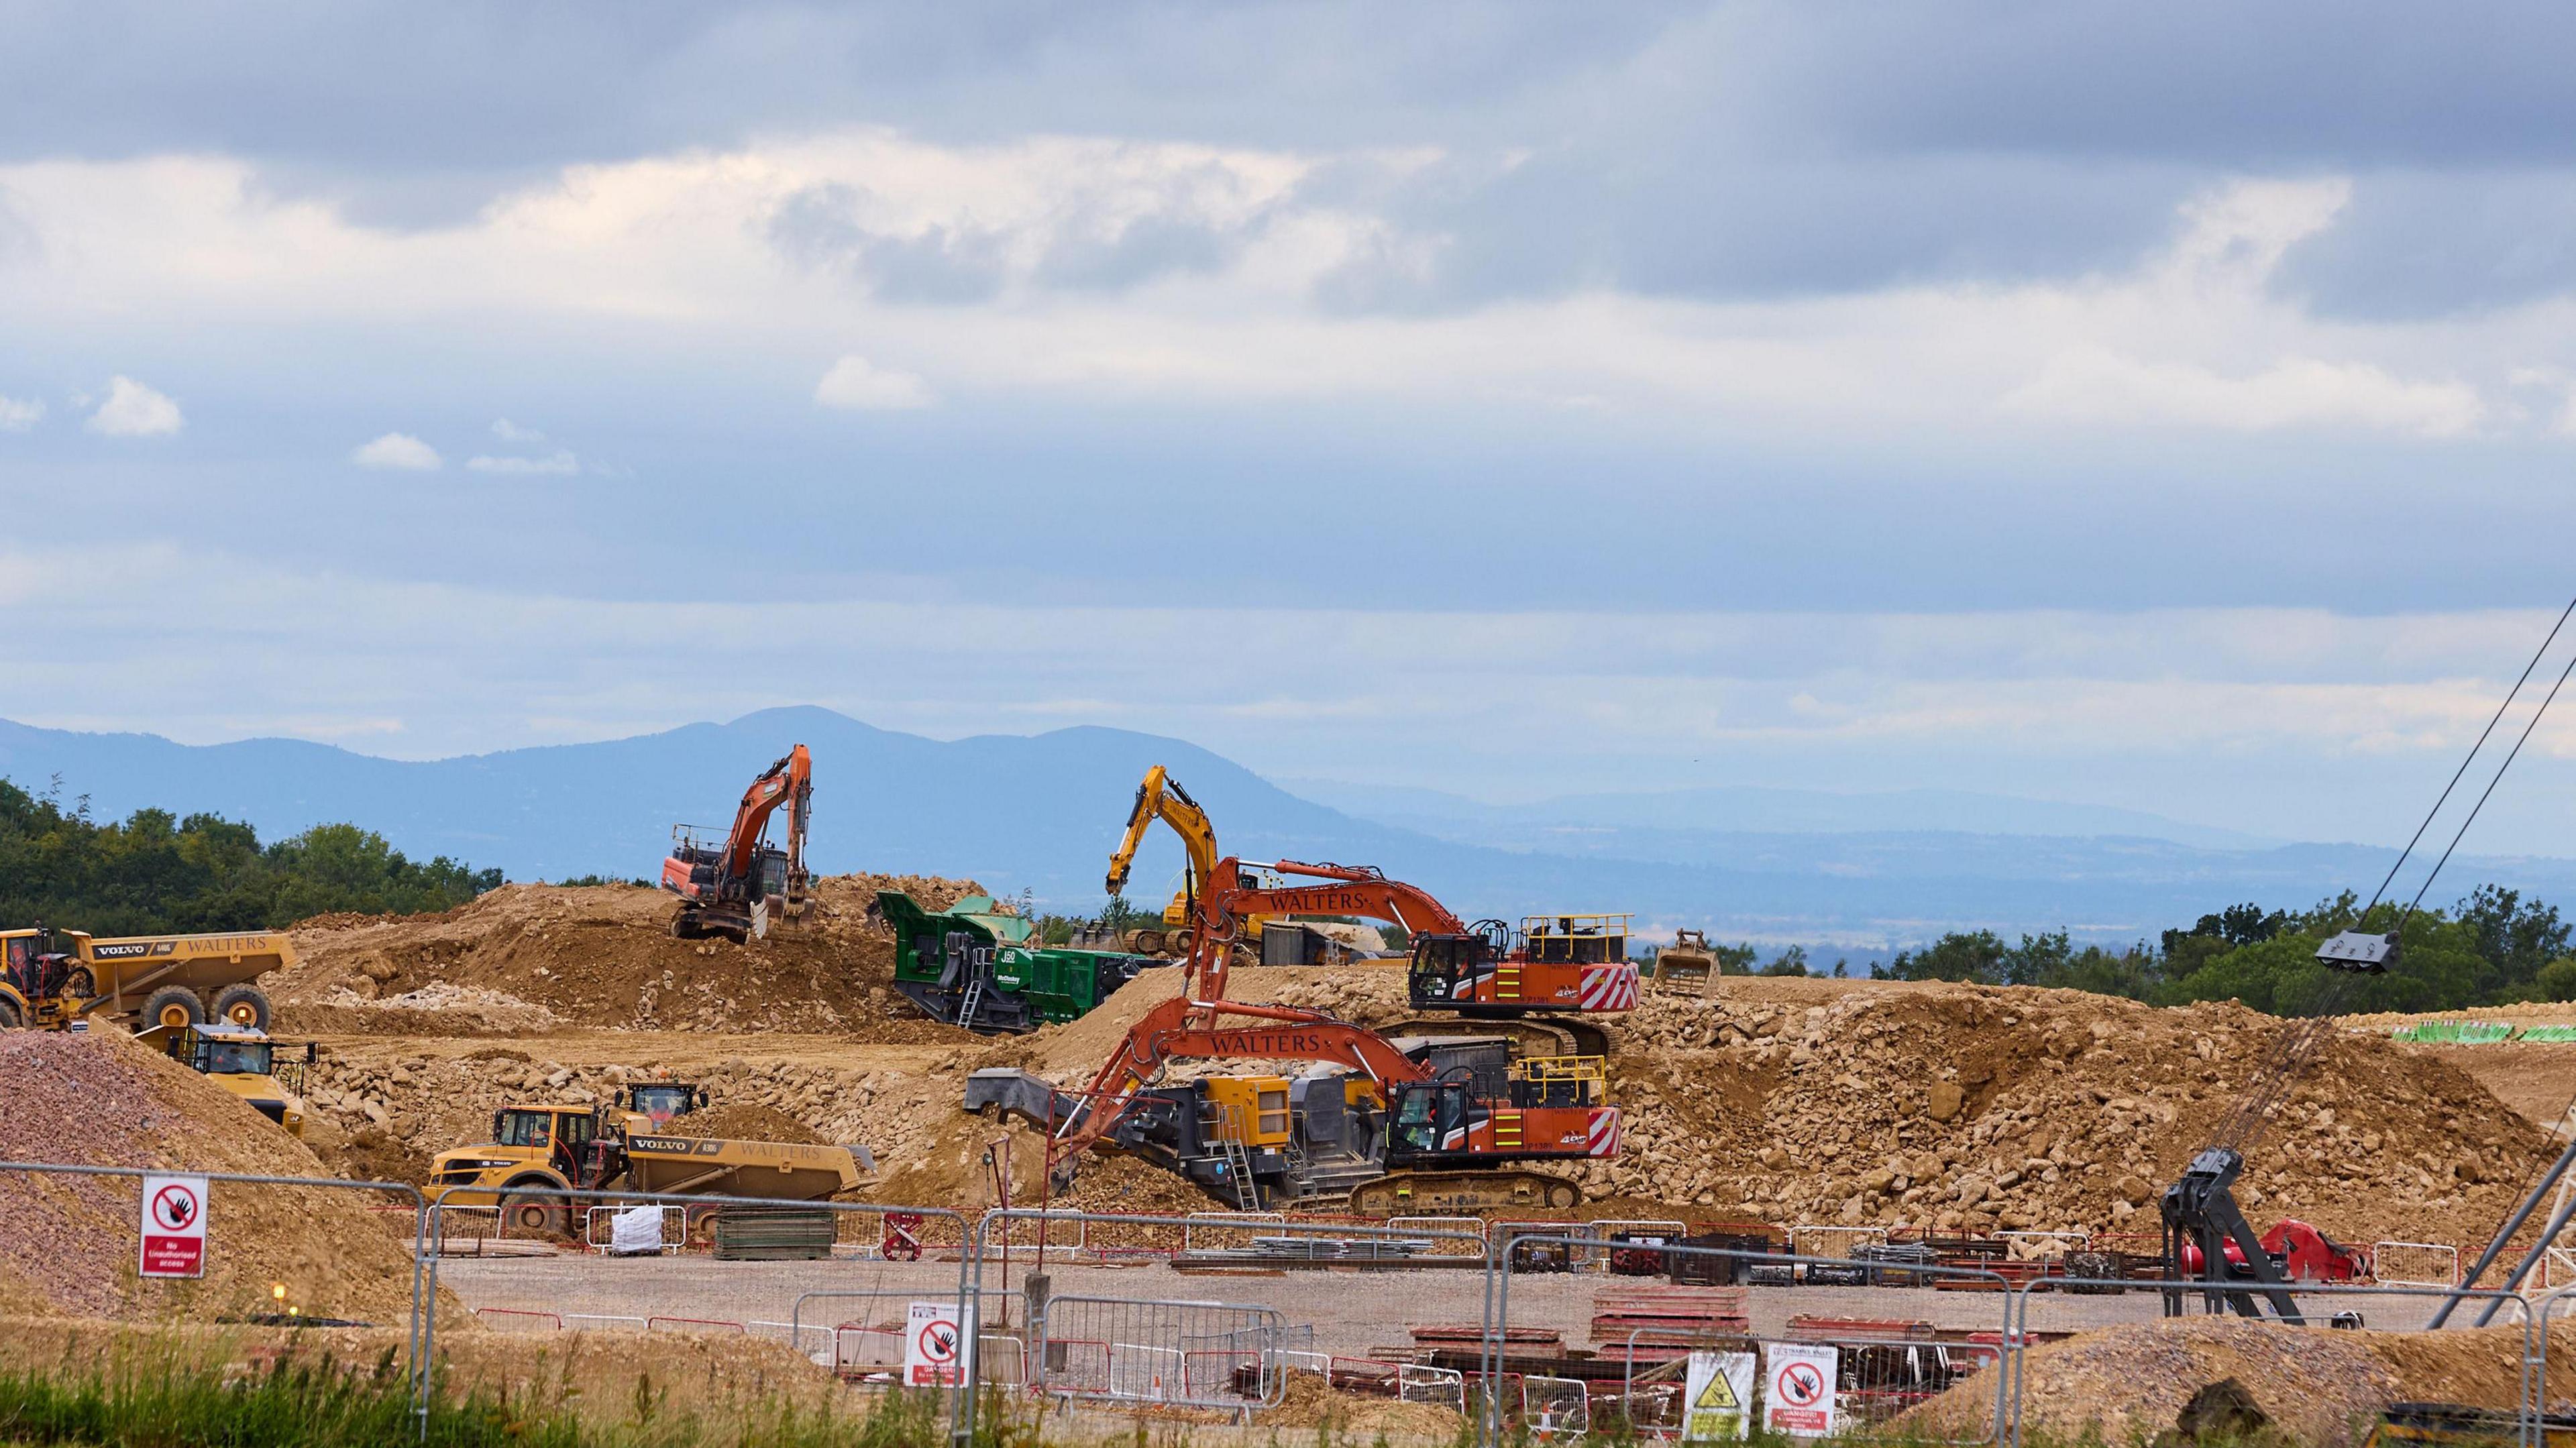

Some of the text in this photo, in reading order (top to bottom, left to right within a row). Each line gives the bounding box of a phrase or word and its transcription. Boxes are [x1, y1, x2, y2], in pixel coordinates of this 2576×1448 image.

[1270, 893, 1364, 911] WALTERS
[99, 945, 144, 956] VOLVO
[187, 937, 266, 953] WALTERS
[1001, 950, 1016, 963] J50
[1210, 1034, 1320, 1054] WALTERS
[635, 1140, 686, 1150] VOLVO
[739, 1144, 820, 1160] WALTERS
[166, 1241, 178, 1250] No
[148, 1250, 197, 1260] Unauthorised
[159, 1260, 184, 1268] access
